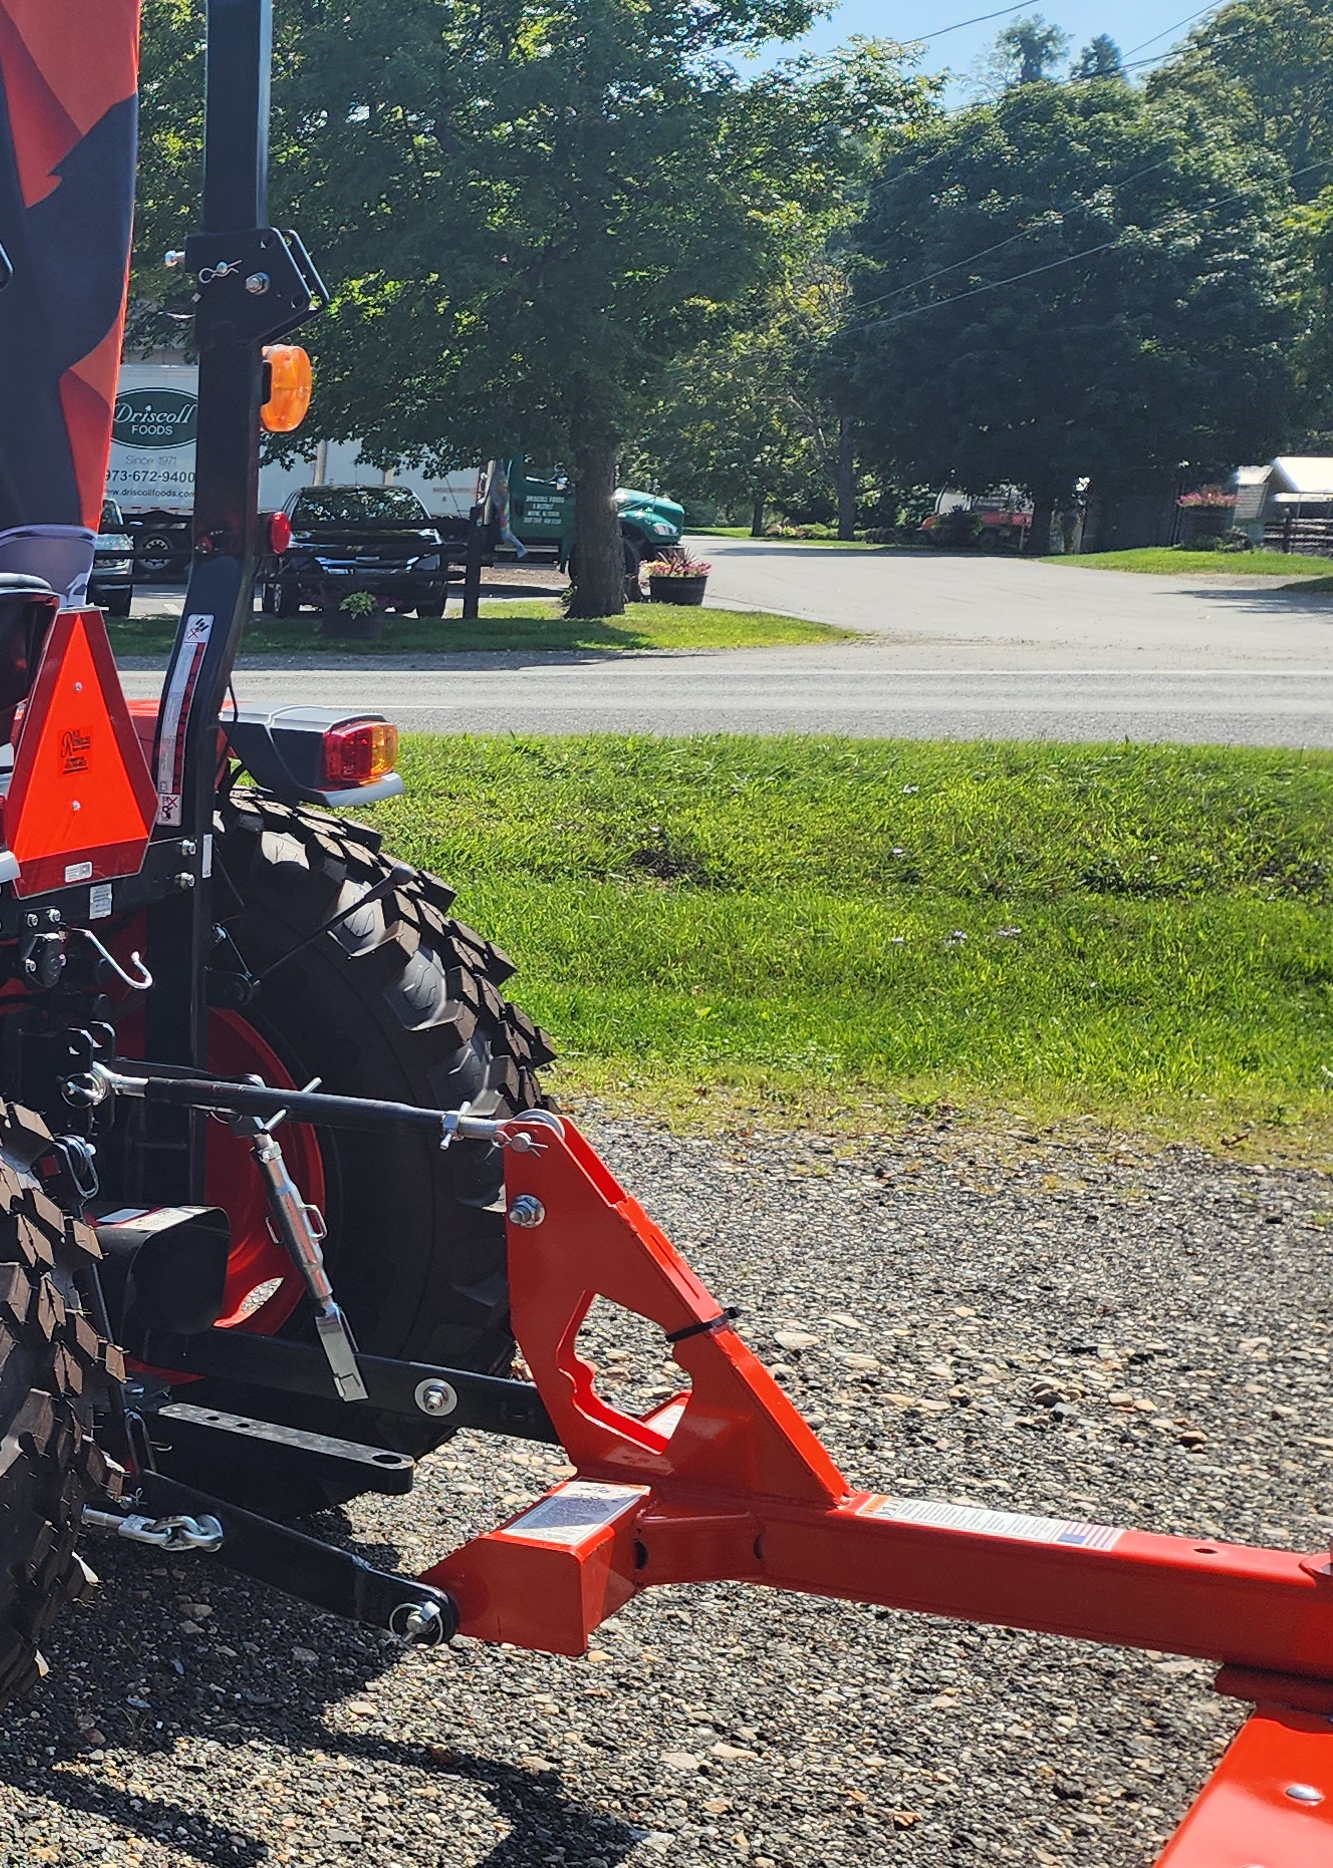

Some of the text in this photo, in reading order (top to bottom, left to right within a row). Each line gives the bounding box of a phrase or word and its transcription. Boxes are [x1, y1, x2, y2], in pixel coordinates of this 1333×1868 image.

[113, 403, 198, 423] Driscoll
[131, 425, 173, 435] FOODS
[126, 455, 154, 465] Since
